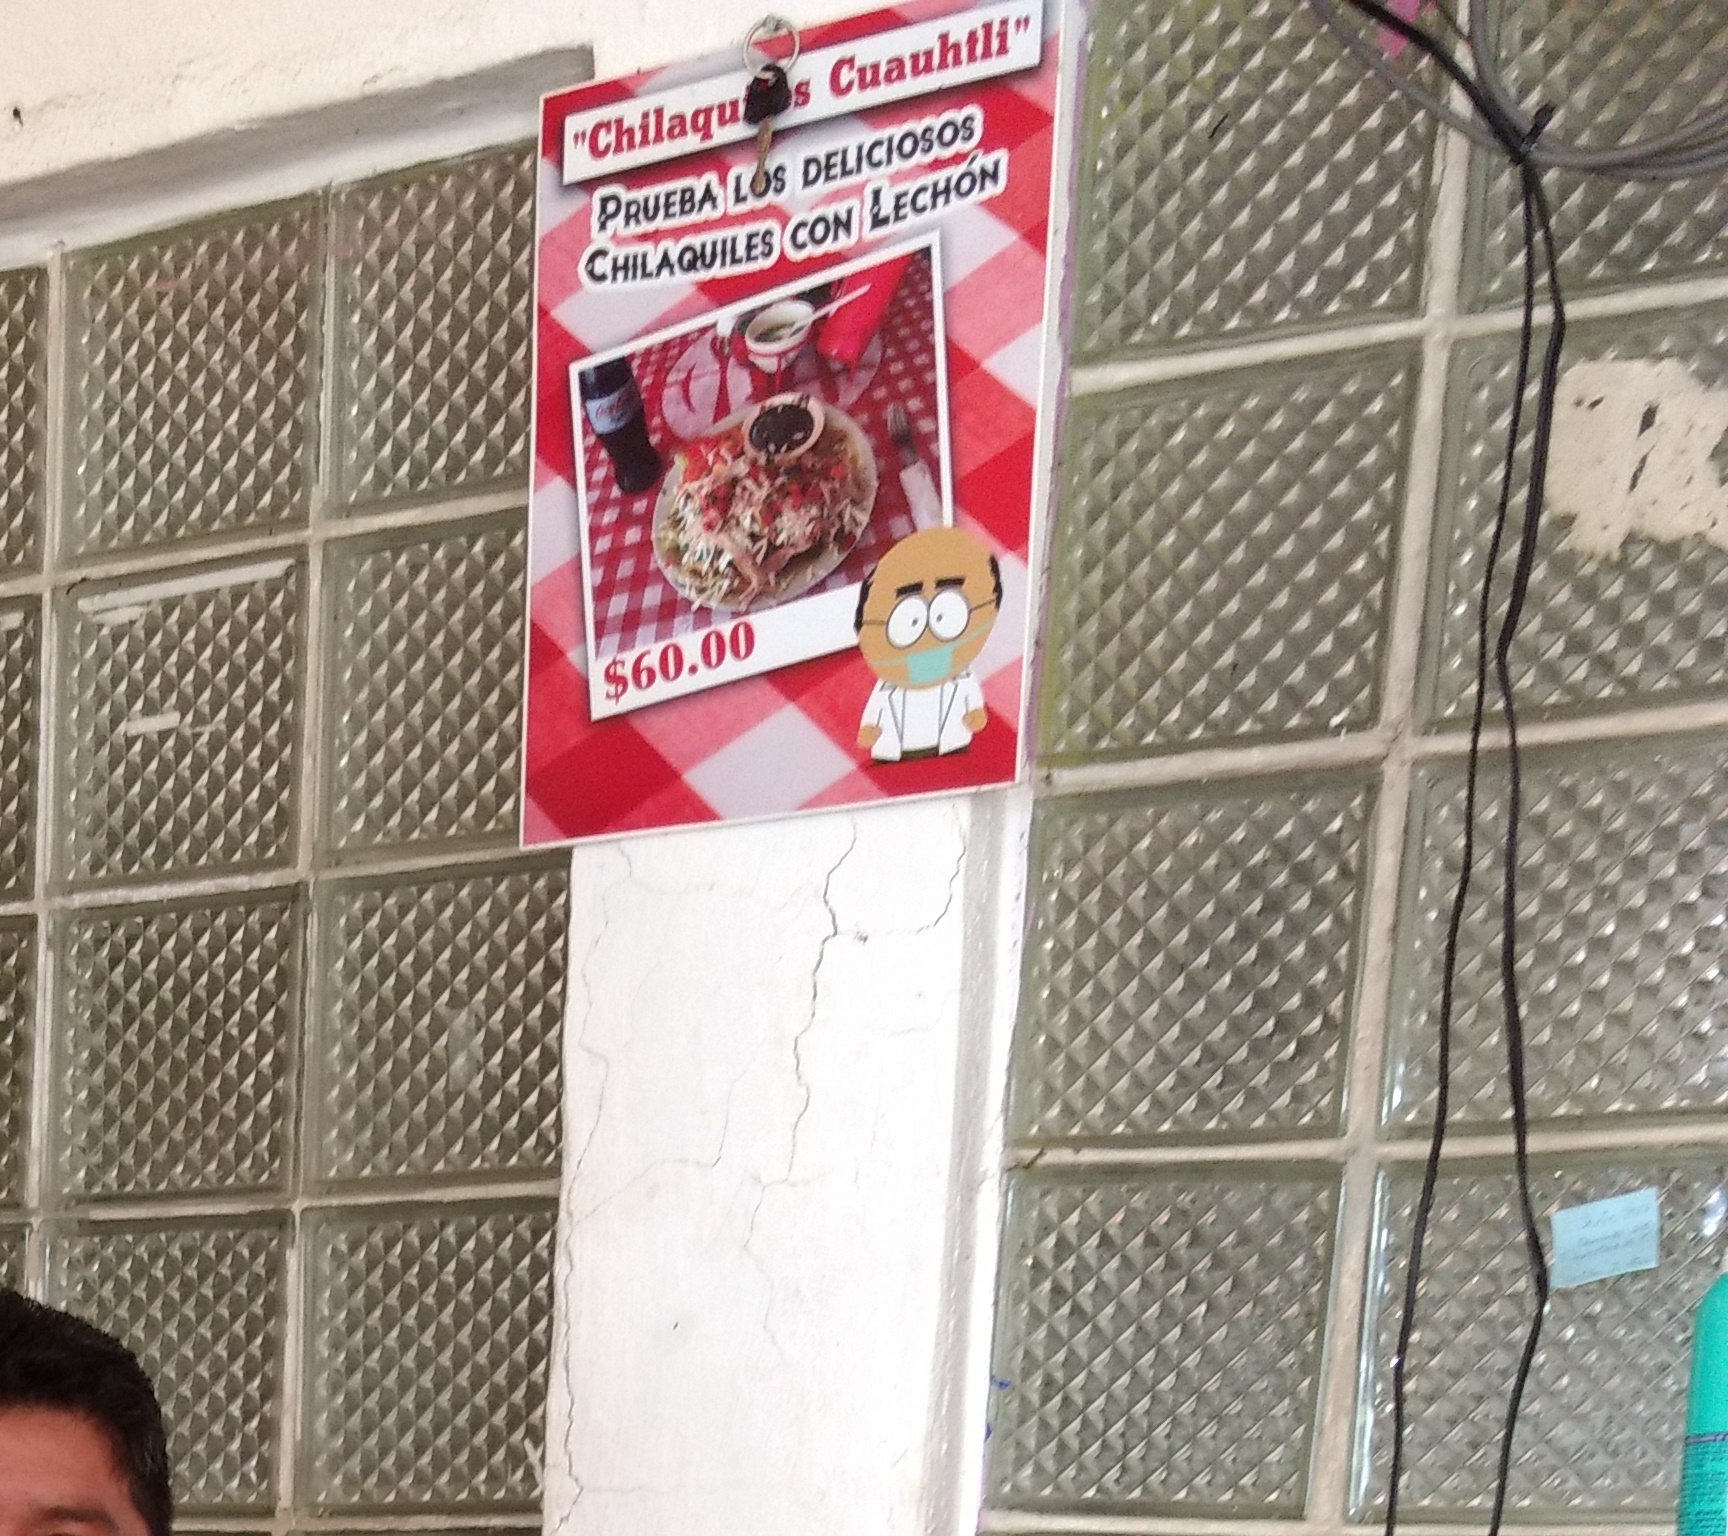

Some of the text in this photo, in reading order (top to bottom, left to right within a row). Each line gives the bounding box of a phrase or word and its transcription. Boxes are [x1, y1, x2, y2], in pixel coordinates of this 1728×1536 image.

[572, 14, 1031, 161] "Chilaqus Cuauhtli"
[585, 228, 775, 284] CHILAQUILES
[603, 621, 757, 702] $60.00
